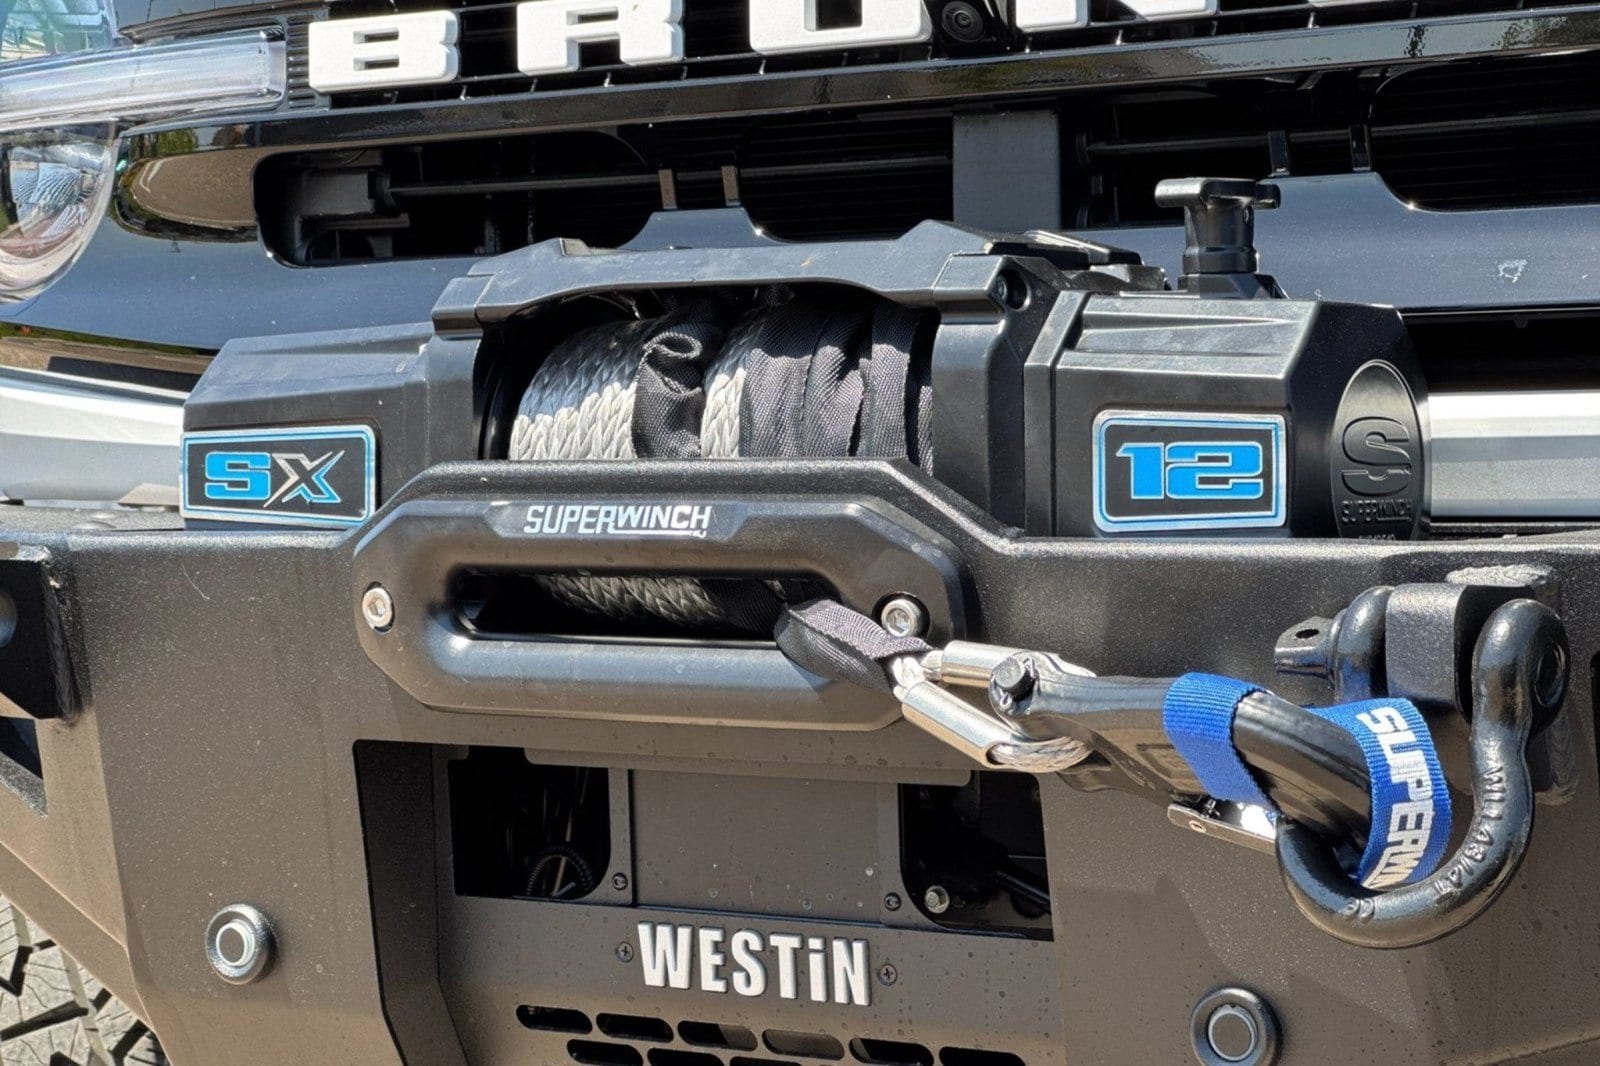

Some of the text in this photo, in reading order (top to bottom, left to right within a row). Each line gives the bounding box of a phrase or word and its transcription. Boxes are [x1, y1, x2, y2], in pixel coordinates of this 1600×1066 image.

[204, 449, 345, 507] SX
[1115, 441, 1264, 500] 12
[523, 504, 712, 538] SUPERWINCH
